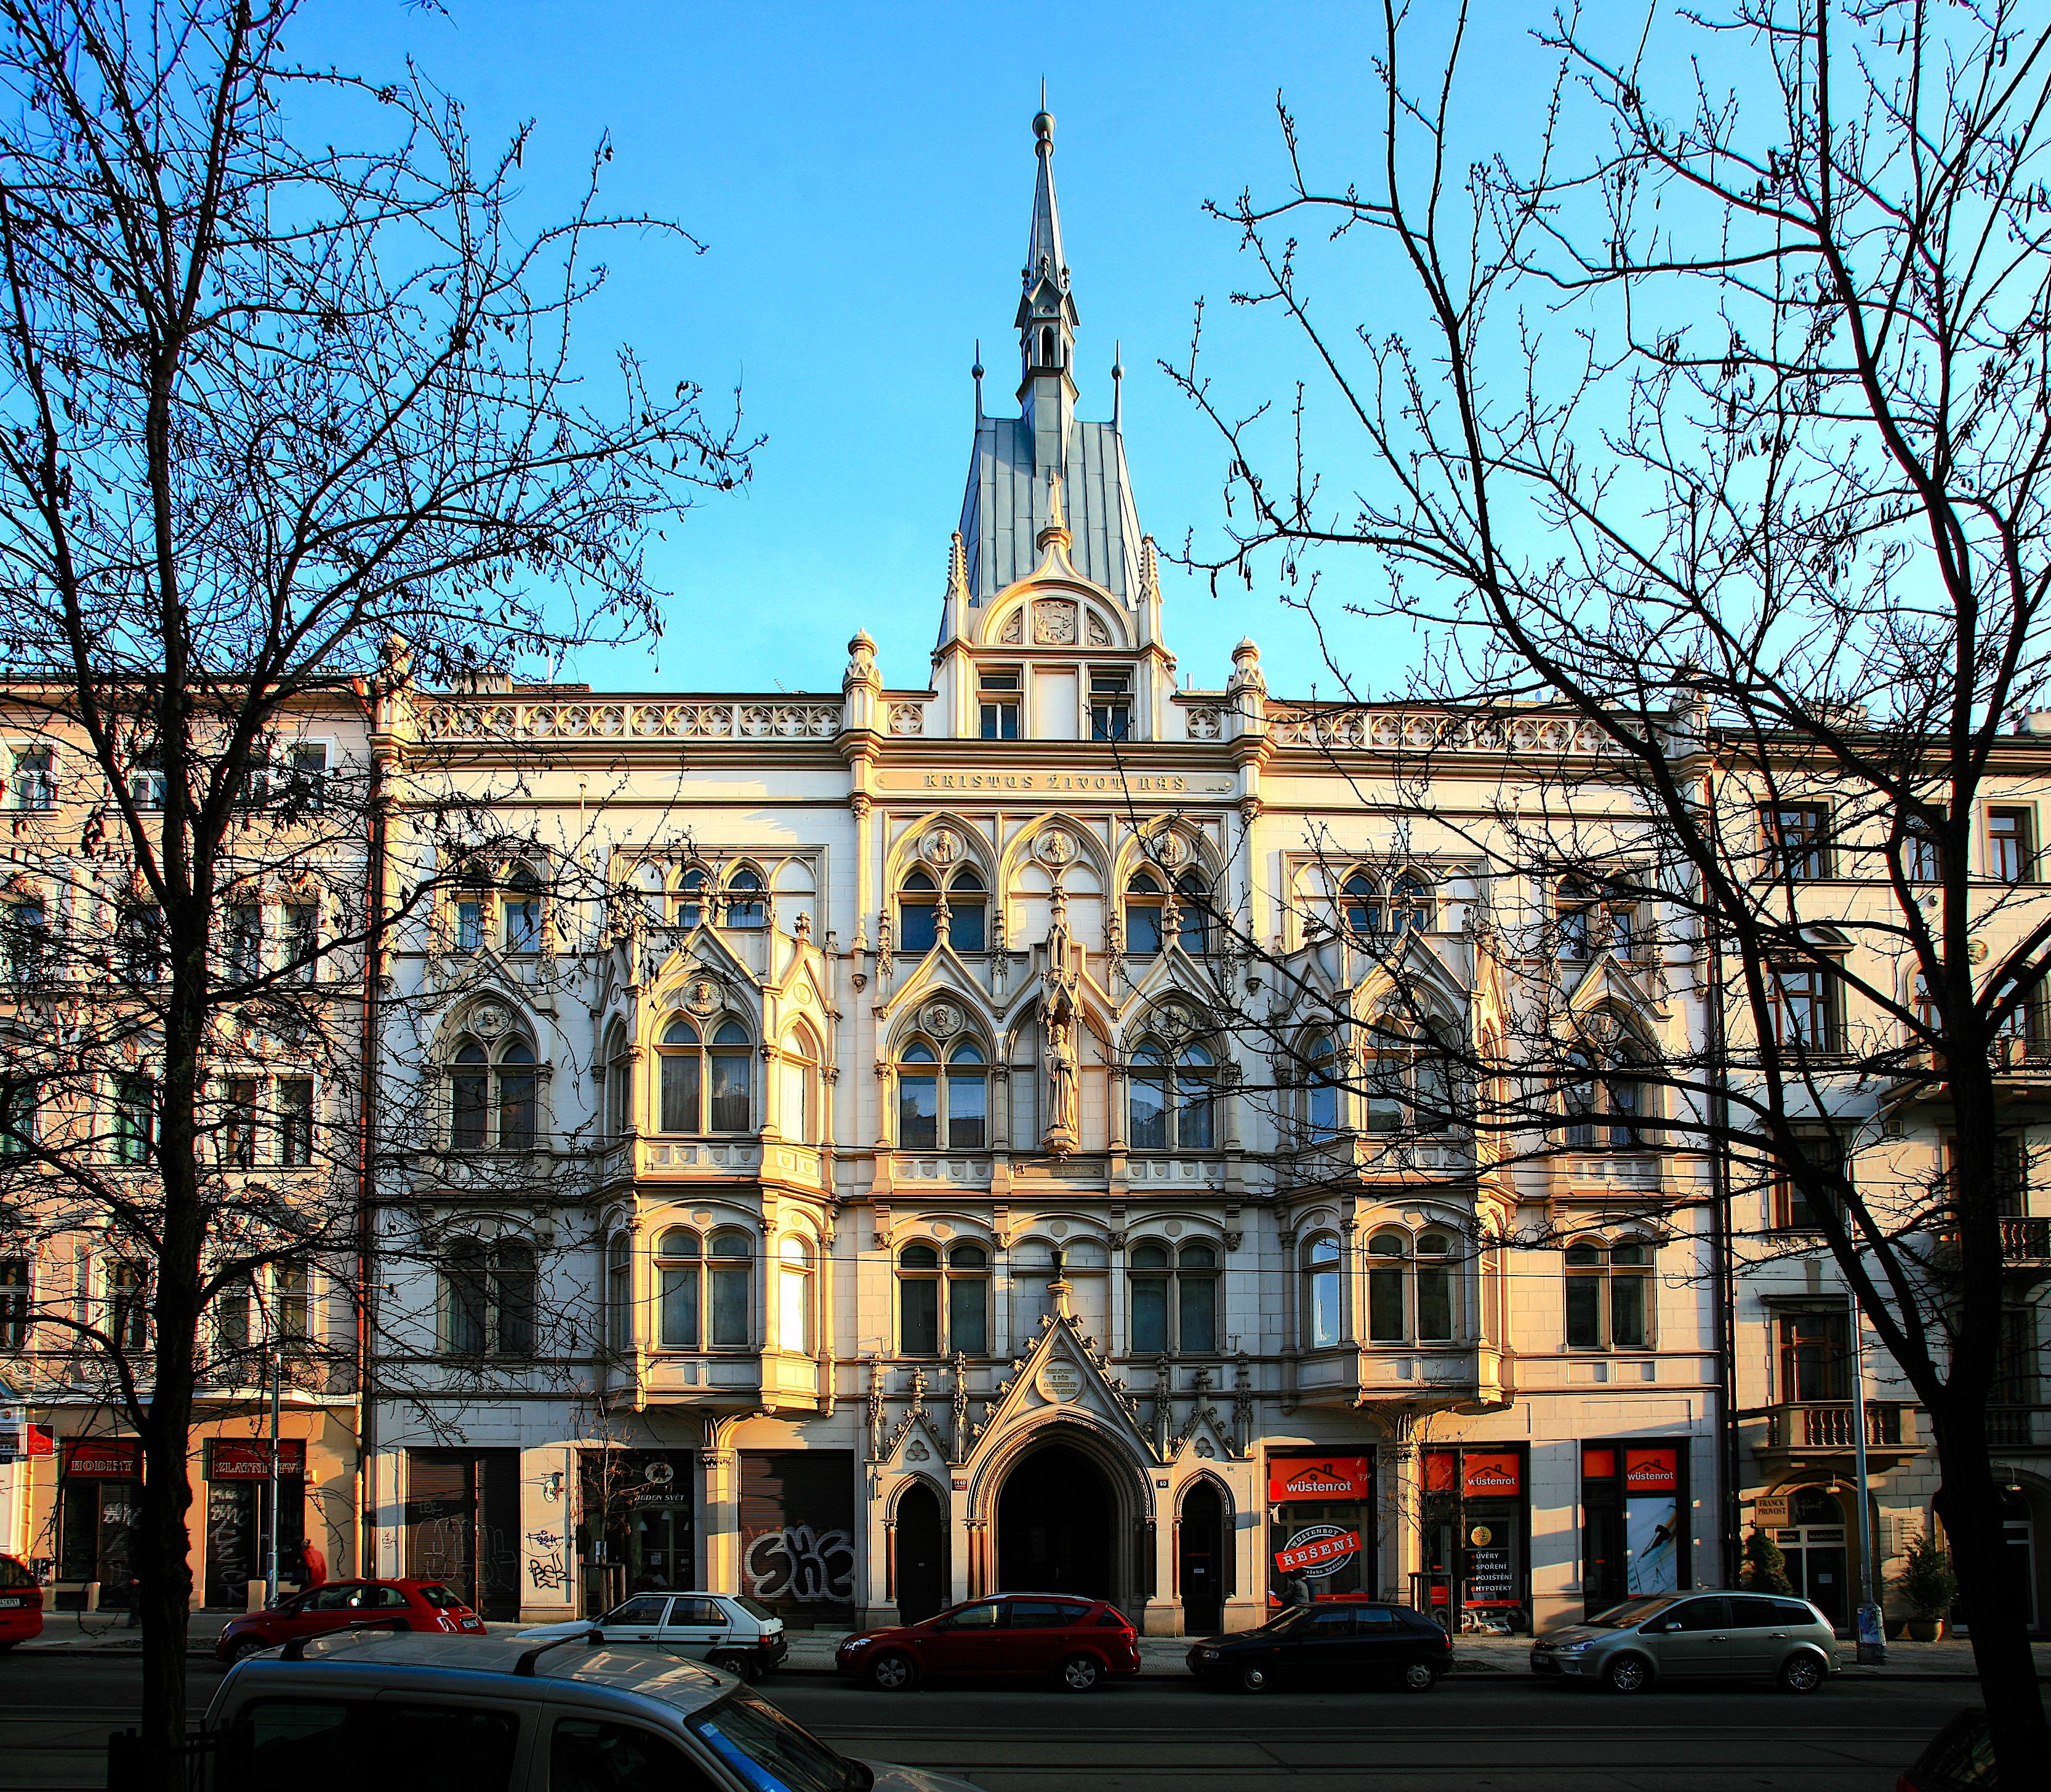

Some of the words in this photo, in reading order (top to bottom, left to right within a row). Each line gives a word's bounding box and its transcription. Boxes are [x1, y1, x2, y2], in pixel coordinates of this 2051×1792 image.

[923, 774, 1035, 788] KRISTUS
[1628, 1472, 1674, 1480] wüstenrot
[1467, 1477, 1515, 1485] wüstenrot
[1286, 1481, 1352, 1492] wüstenrot
[1282, 1535, 1355, 1566] ŘEŠENÍ
[1476, 1562, 1507, 1570] SPOŘENÍ
